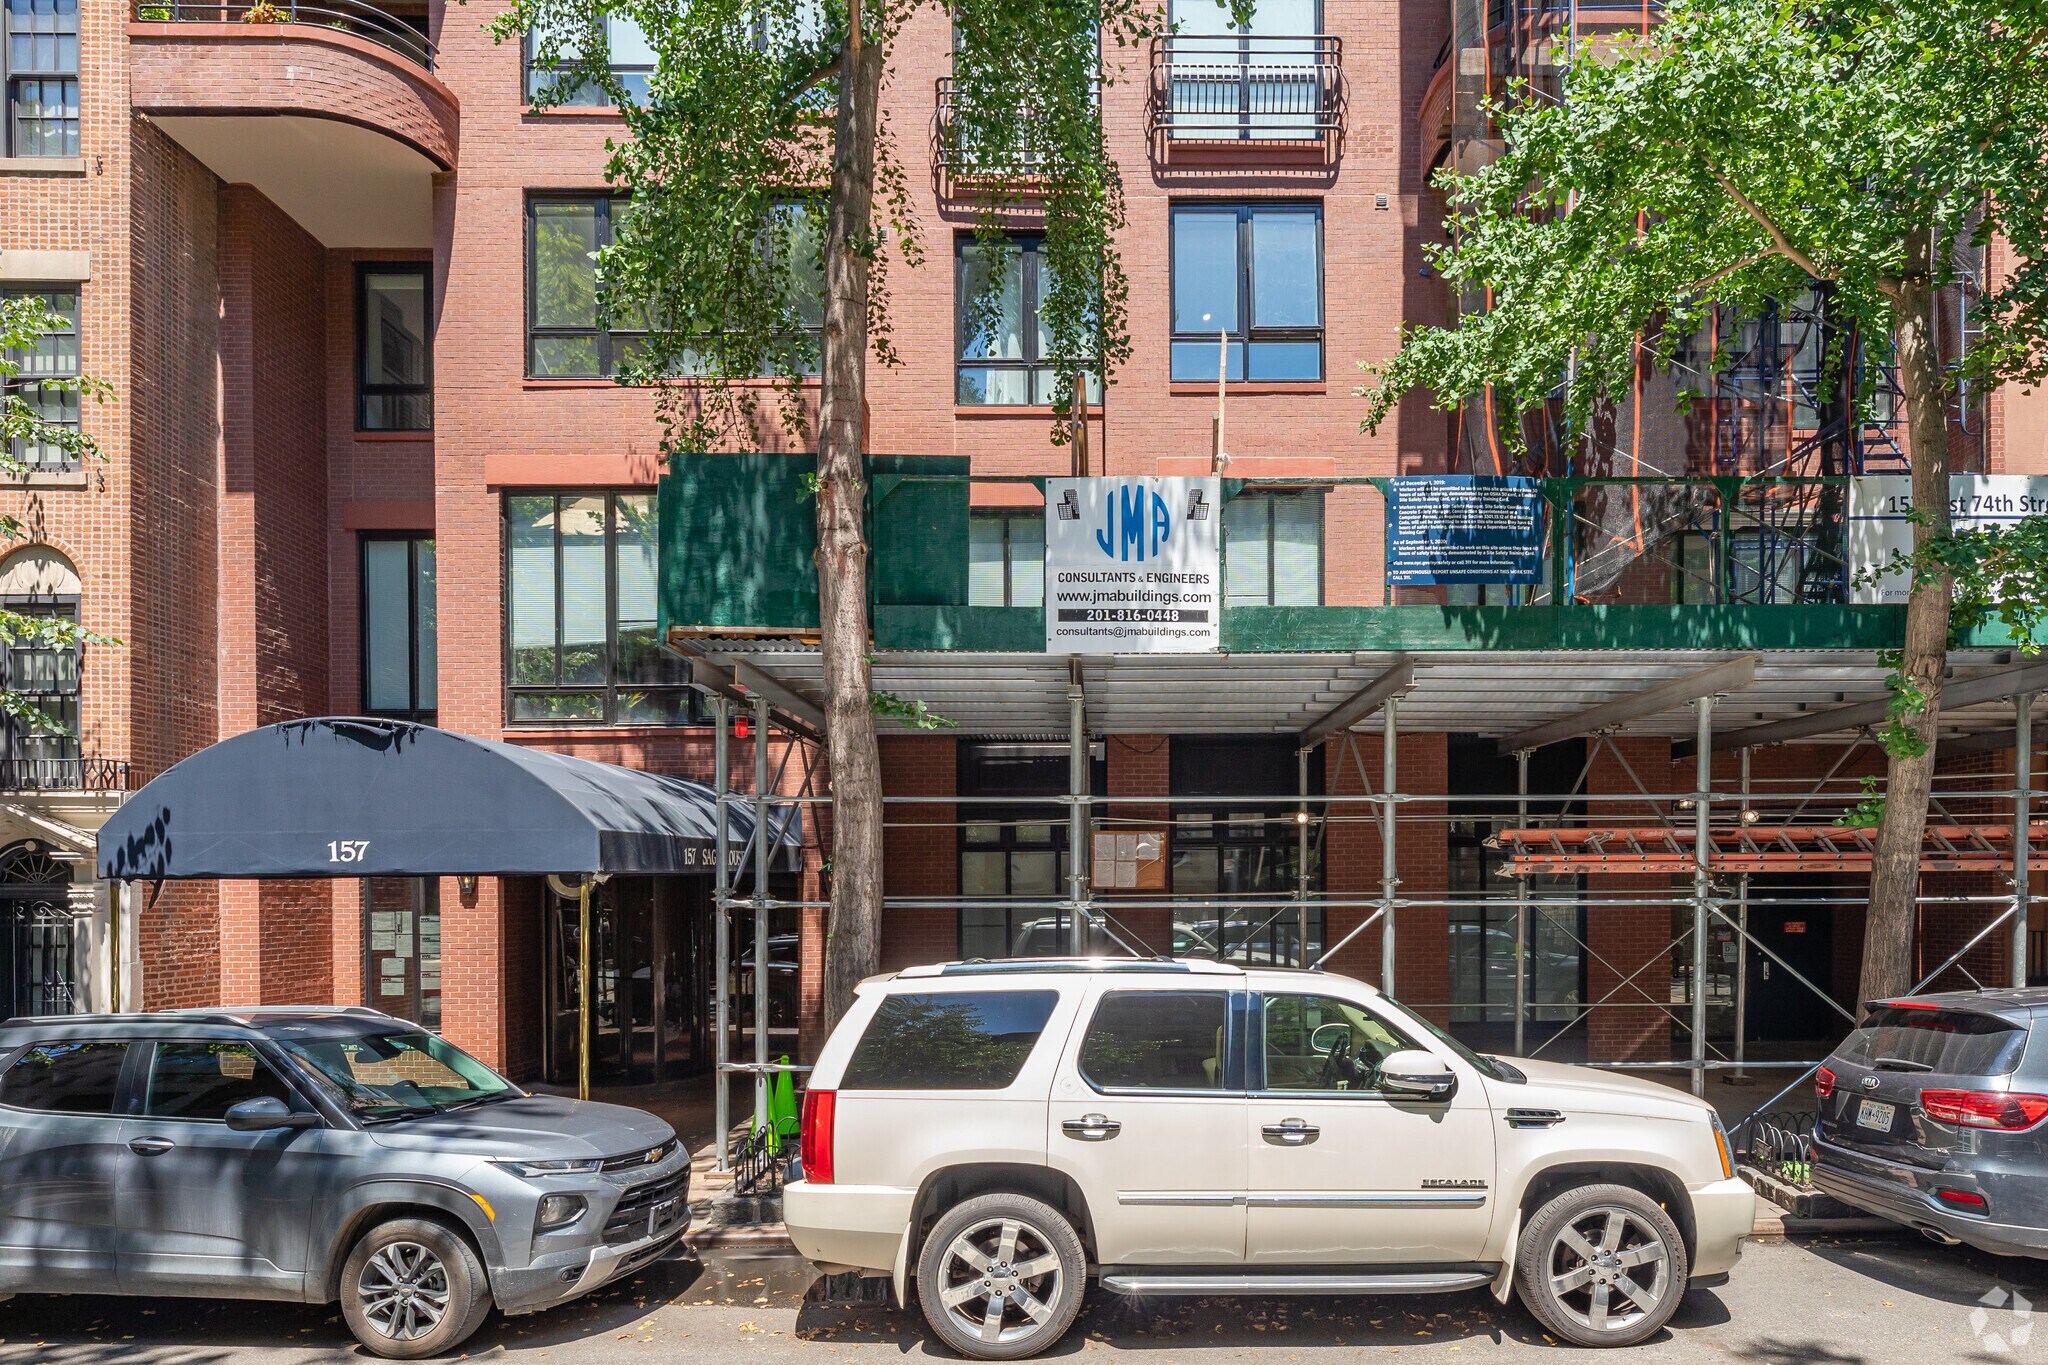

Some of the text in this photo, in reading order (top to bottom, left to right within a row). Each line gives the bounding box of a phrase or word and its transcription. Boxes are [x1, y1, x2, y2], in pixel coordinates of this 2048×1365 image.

[1972, 494, 2013, 512] 74th
[1096, 484, 1170, 562] JMA
[1058, 572, 1136, 583] CONSULTANTS
[1146, 573, 1210, 584] ENGINEERS
[1057, 590, 1212, 605] www.jmabuildings.com
[1086, 609, 1180, 622] 201-816-0448
[1056, 627, 1211, 638] consultants@jmabuildings.com
[327, 840, 371, 862] 157
[684, 848, 696, 865] 157
[702, 848, 716, 865] SAG
